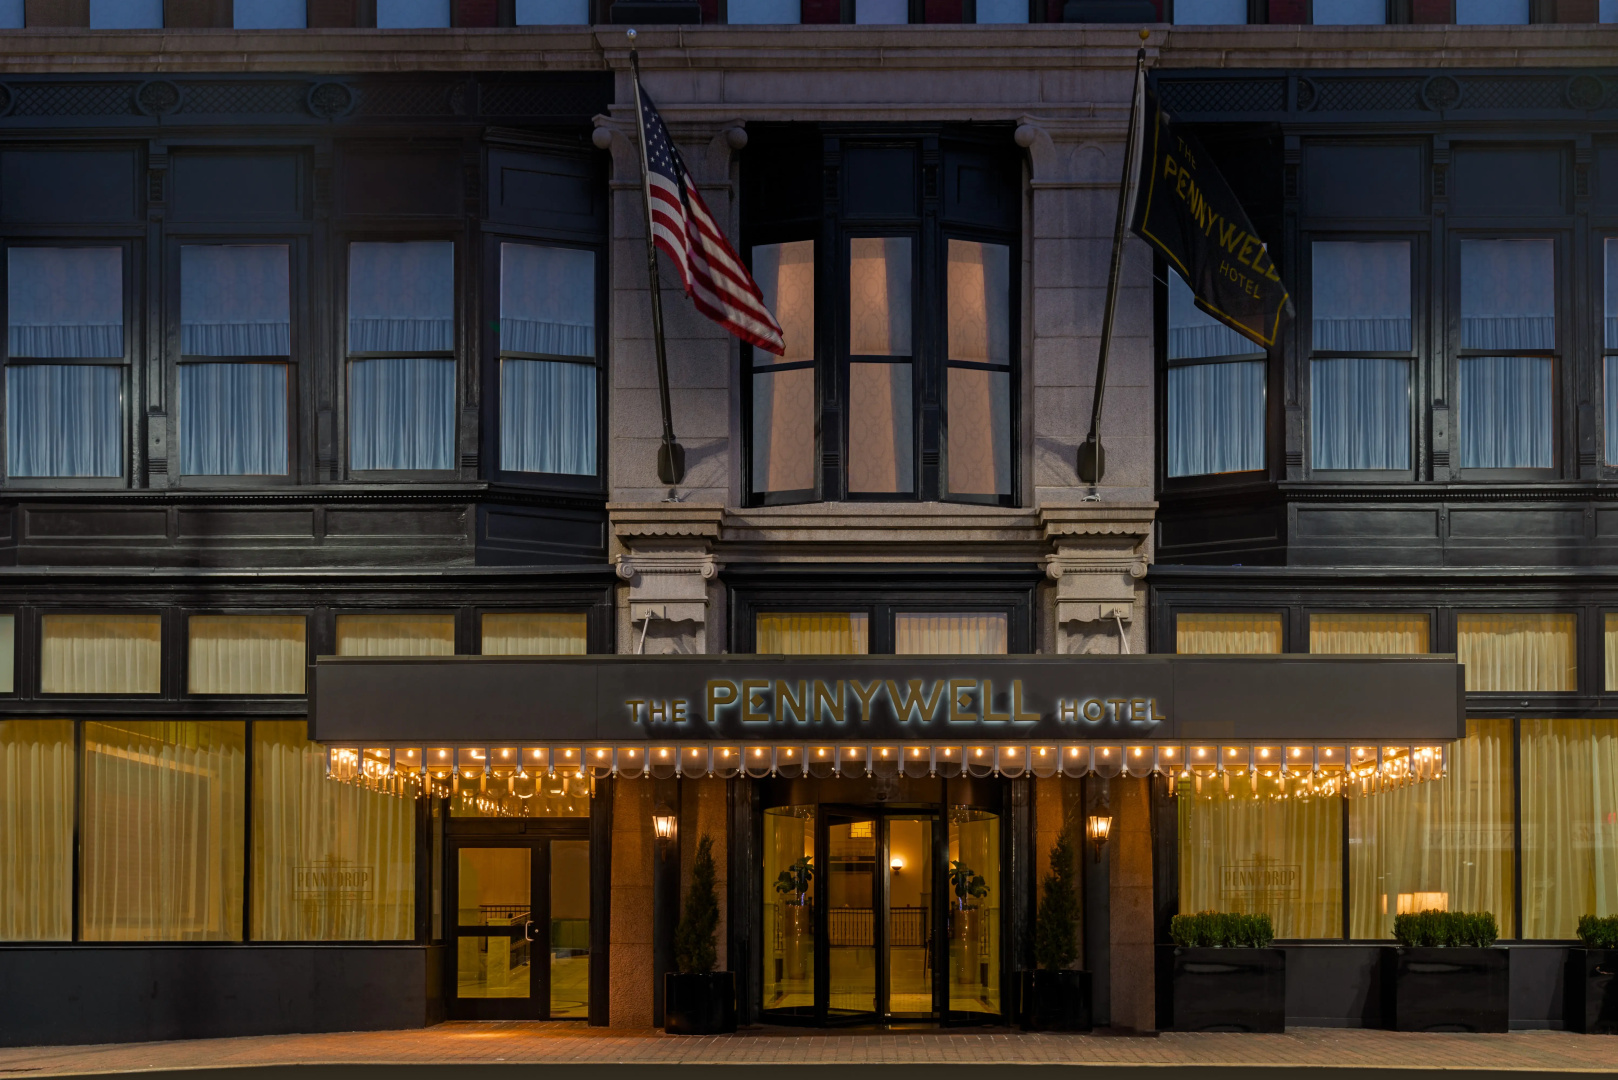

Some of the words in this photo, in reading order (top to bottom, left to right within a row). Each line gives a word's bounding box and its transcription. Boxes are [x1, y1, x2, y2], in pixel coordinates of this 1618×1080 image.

[1178, 136, 1197, 170] THE
[1219, 260, 1261, 299] HOTEL
[625, 699, 687, 722] THE
[706, 679, 1041, 722] PENNYWELL
[1060, 698, 1166, 721] HOTEL
